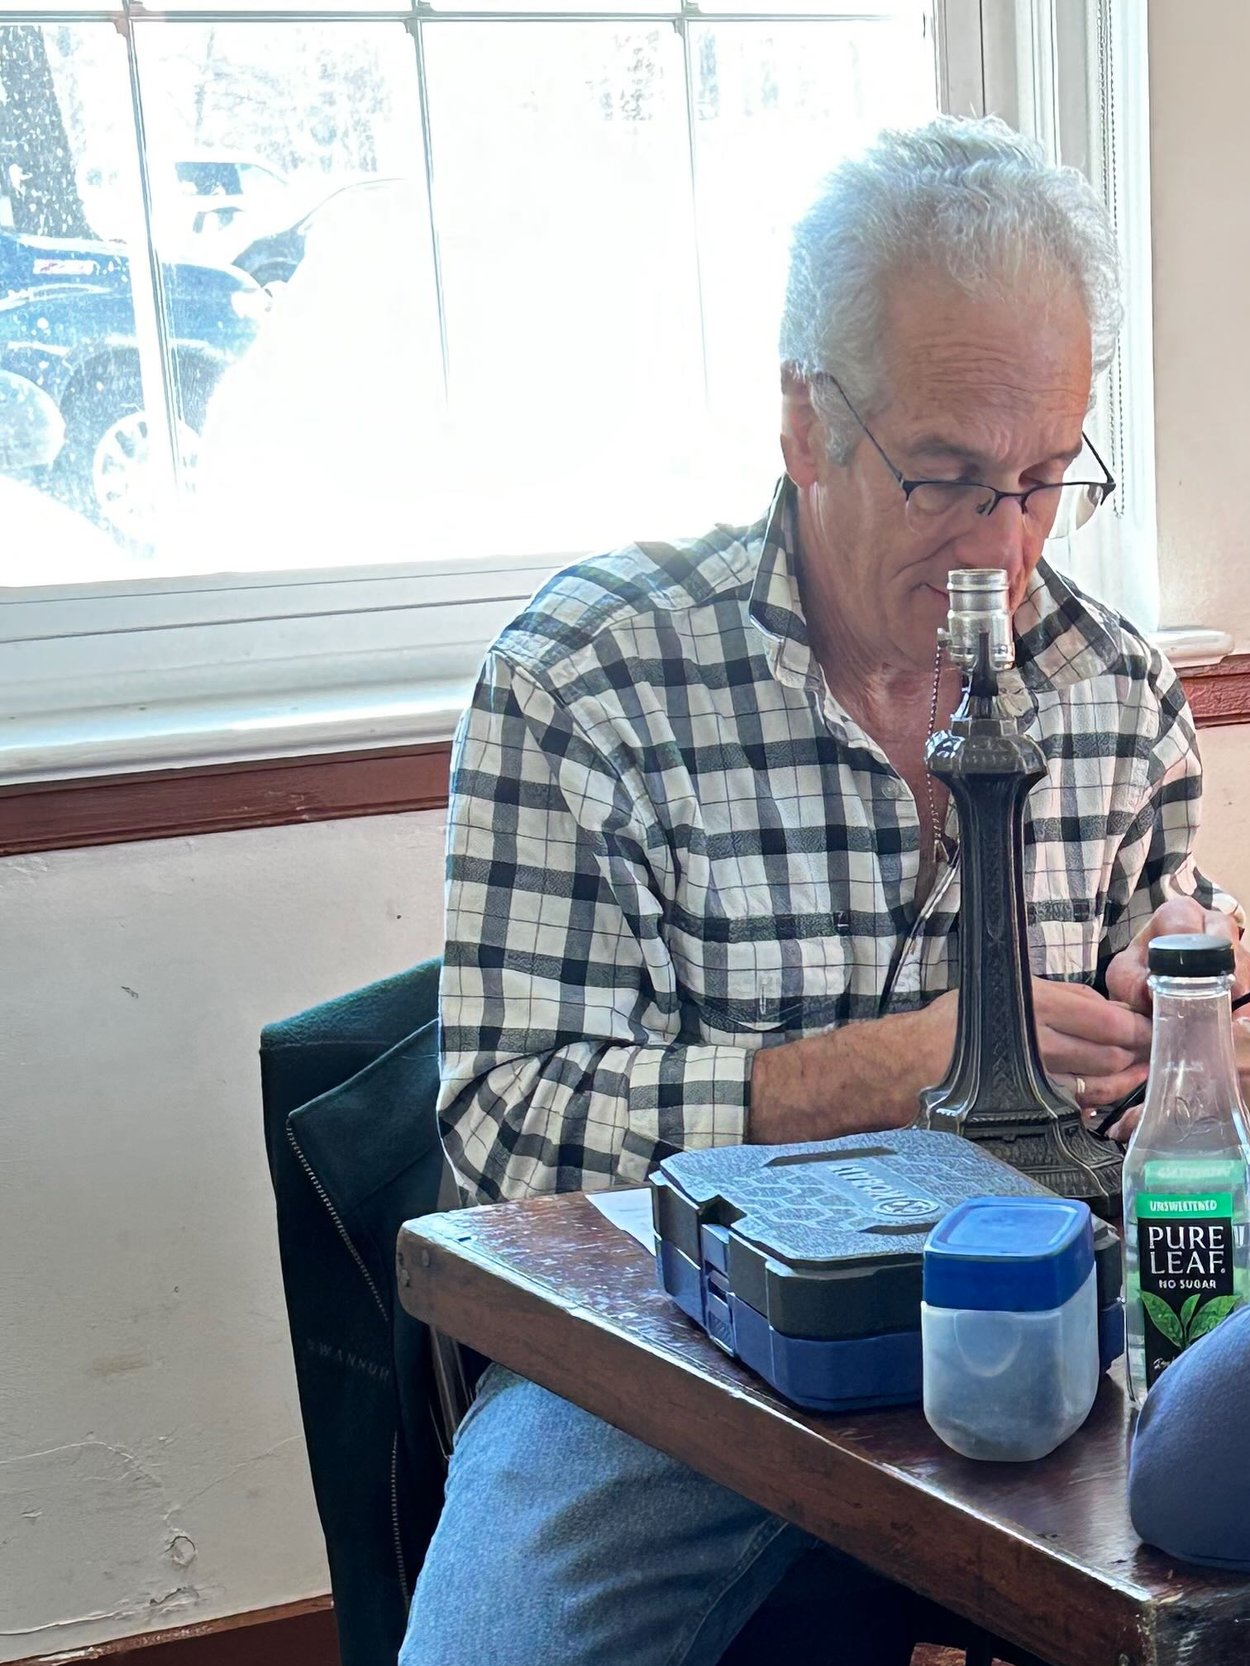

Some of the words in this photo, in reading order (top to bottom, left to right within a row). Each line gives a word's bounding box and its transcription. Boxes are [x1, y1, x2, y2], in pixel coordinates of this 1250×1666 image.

[1150, 1200, 1217, 1212] UNSWEETENED
[1148, 1226, 1225, 1249] PURE
[1149, 1251, 1223, 1274] LEAF
[1158, 1280, 1176, 1289] NO
[1180, 1280, 1217, 1289] SUGAR
